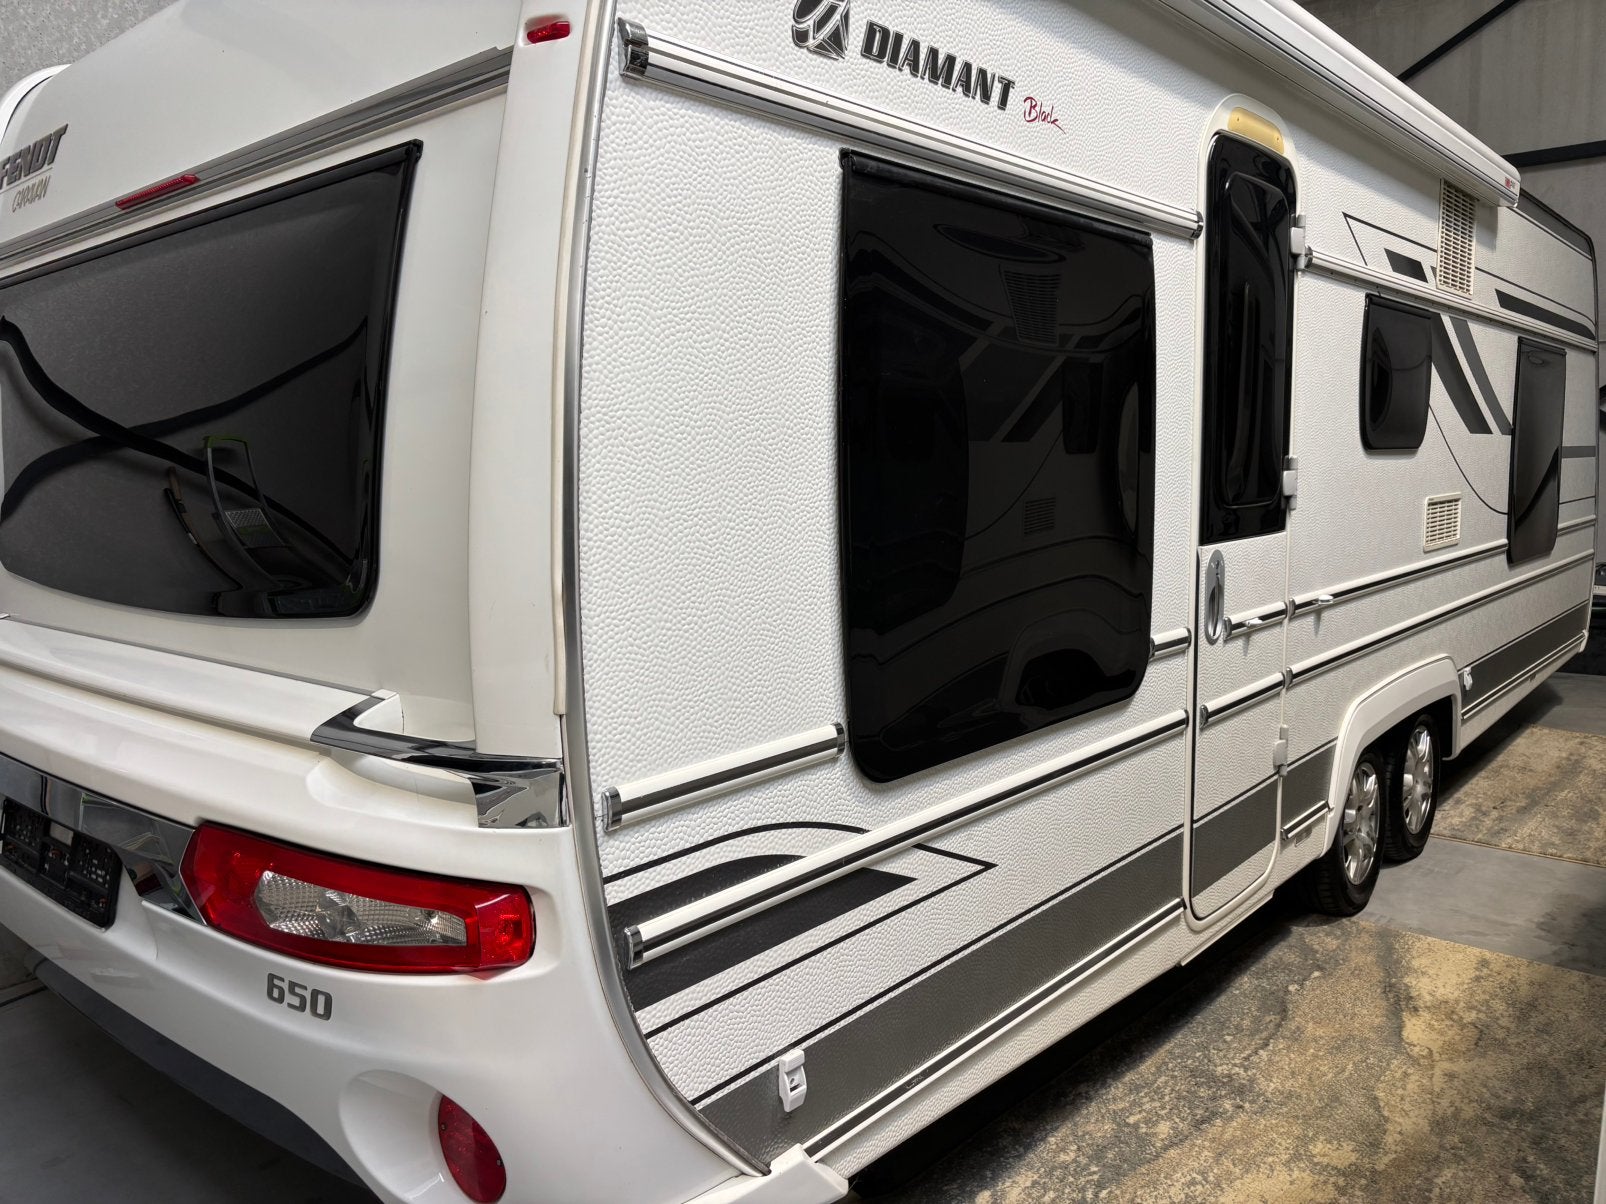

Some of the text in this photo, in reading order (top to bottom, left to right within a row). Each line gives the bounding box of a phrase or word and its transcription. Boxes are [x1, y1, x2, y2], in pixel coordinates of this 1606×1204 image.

[860, 19, 1066, 134] DIAMANT Black
[0, 123, 68, 191] FENDT
[267, 973, 333, 1021] 650
